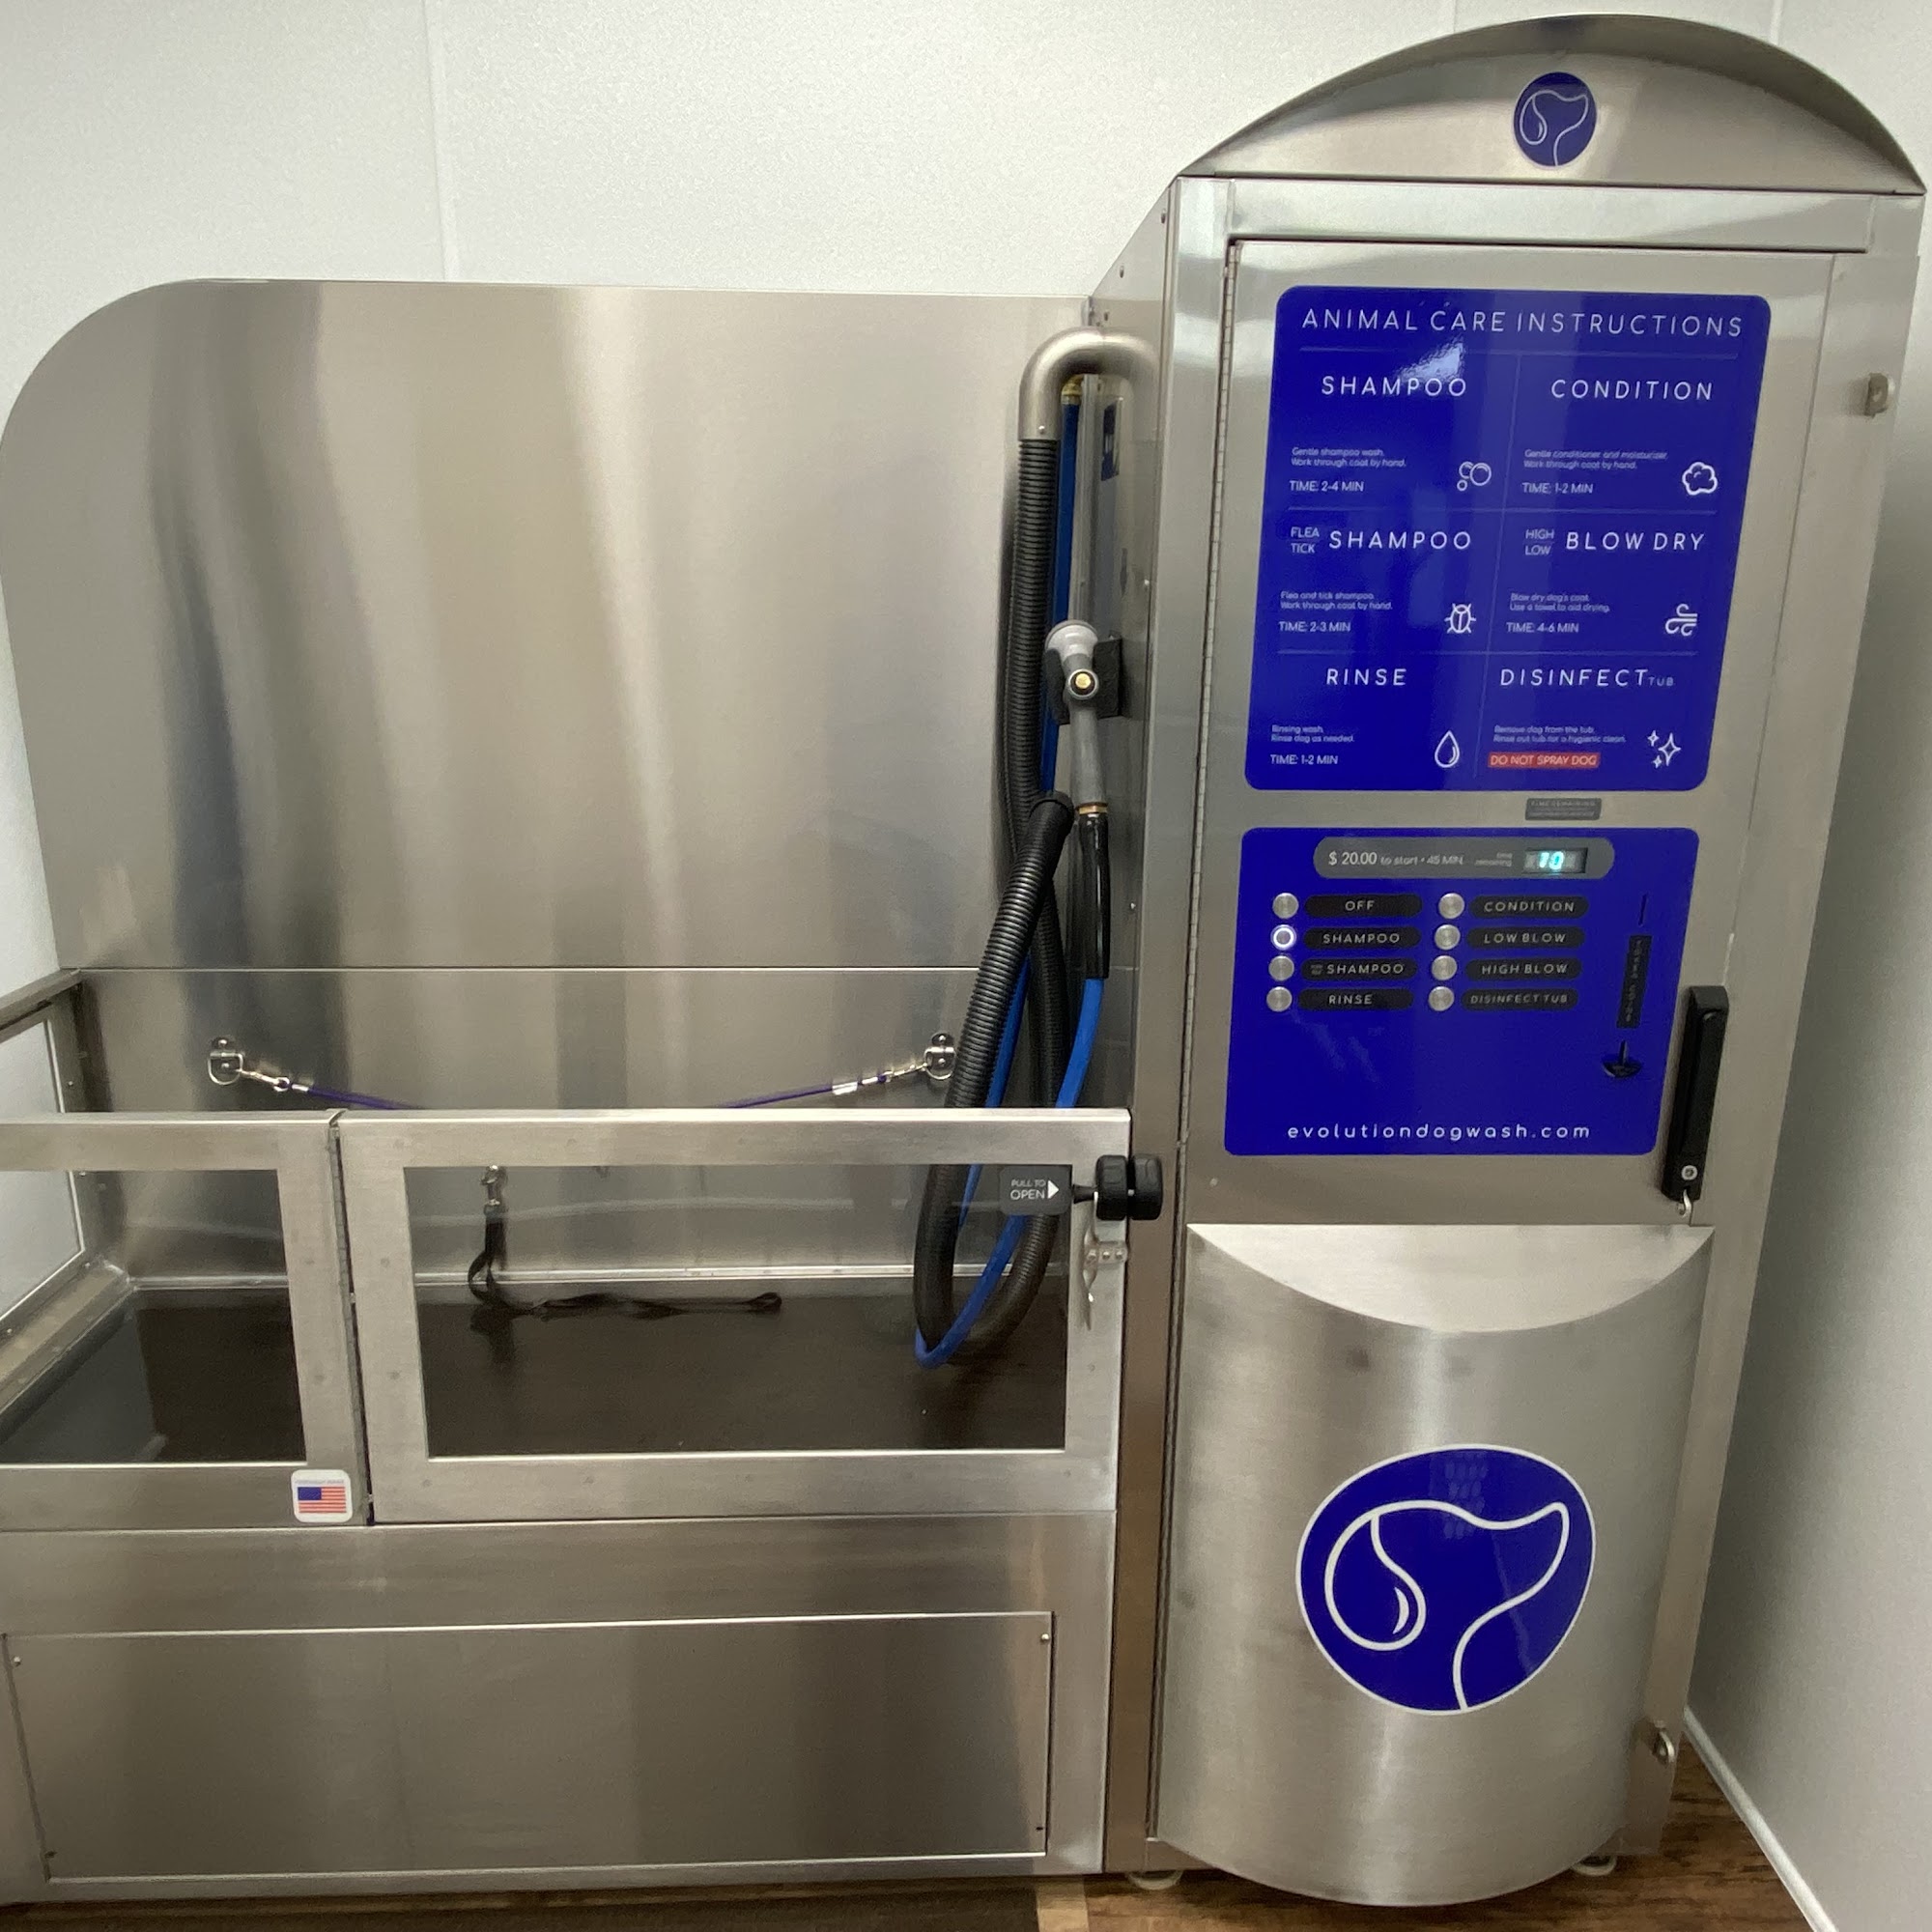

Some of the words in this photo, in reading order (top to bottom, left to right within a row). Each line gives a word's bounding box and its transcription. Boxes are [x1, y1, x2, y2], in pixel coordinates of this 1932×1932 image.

[1301, 308, 1418, 330] ANIMAL
[1430, 310, 1506, 332] CARE
[1517, 312, 1742, 337] INSTRUCTIONS
[1321, 375, 1466, 396] SHAMPOO
[1550, 380, 1713, 401] CONDITION
[1292, 447, 1320, 456] Gentle
[1321, 447, 1361, 458] shampoo
[1524, 448, 1551, 458] Gentle
[1552, 449, 1601, 459] conditioner
[1603, 450, 1620, 459] and
[1291, 458, 1312, 467] Work
[1313, 458, 1348, 469] through
[1349, 459, 1369, 468] coat
[1370, 459, 1381, 469] by
[1381, 459, 1407, 468] hand.
[1523, 460, 1545, 469] Work
[1546, 460, 1579, 470] through
[1580, 461, 1601, 469] coat
[1602, 461, 1612, 470] by
[1613, 461, 1638, 469] hand.
[1321, 480, 1339, 492] 2-4
[1341, 481, 1364, 492] MIN
[1521, 482, 1552, 494] TIME:
[1554, 482, 1568, 494] 1-2
[1571, 483, 1594, 494] MIN
[1291, 526, 1320, 538] FLEA
[1524, 528, 1555, 540] HIGH
[1328, 530, 1471, 550] SHAMPOO
[1566, 531, 1644, 551] BLOW
[1653, 532, 1704, 551] DRY
[1291, 543, 1316, 554] TICK
[1524, 545, 1551, 556] LOW
[1510, 592, 1530, 601] Blow
[1530, 593, 1546, 603] dry
[1547, 593, 1569, 603] dog's
[1280, 601, 1301, 610] Work
[1302, 601, 1336, 611] through
[1357, 602, 1368, 611] by
[1369, 602, 1393, 611] hand.
[1509, 603, 1525, 611] Use
[1310, 621, 1327, 632] 2-3
[1328, 622, 1351, 632] MIN
[1536, 622, 1555, 633] 4-6
[1557, 622, 1579, 633] MIN
[1326, 668, 1406, 686] RINSE
[1500, 668, 1648, 687] DISINFECT
[1648, 676, 1675, 687] TUB
[1271, 724, 1301, 734] Rinsing
[1493, 724, 1526, 733] Remove
[1526, 724, 1544, 734] dog
[1293, 734, 1311, 744] dog
[1300, 754, 1315, 765] 1-2
[1316, 754, 1339, 765] MIN
[1490, 754, 1508, 766] DO
[1510, 754, 1535, 766] NOT
[1536, 754, 1570, 766] SPRAY
[1571, 754, 1598, 766] DOG
[1328, 850, 1338, 866] $
[1341, 851, 1378, 866] 20.00
[1379, 856, 1392, 866] to
[1393, 856, 1418, 867] start
[1426, 854, 1440, 865] 45
[1441, 854, 1464, 866] MIN
[1539, 851, 1565, 869] 10
[1345, 900, 1376, 911] OFF
[1484, 900, 1575, 913] CONDITION
[1322, 933, 1401, 944] SHAMPOO
[1484, 933, 1518, 944] LOW
[1521, 933, 1567, 944] BLOW
[1326, 964, 1405, 975] SHAMPOO
[1481, 964, 1520, 975] HIGH
[1523, 964, 1569, 975] BLOW
[1328, 994, 1373, 1005] RINSE
[1470, 994, 1540, 1005] DISINFECT
[1544, 994, 1568, 1004] TUB
[1287, 1122, 1590, 1142] evolutiondogwash.com
[1034, 1179, 1046, 1187] TO
[1009, 1189, 1045, 1200] OPEN
